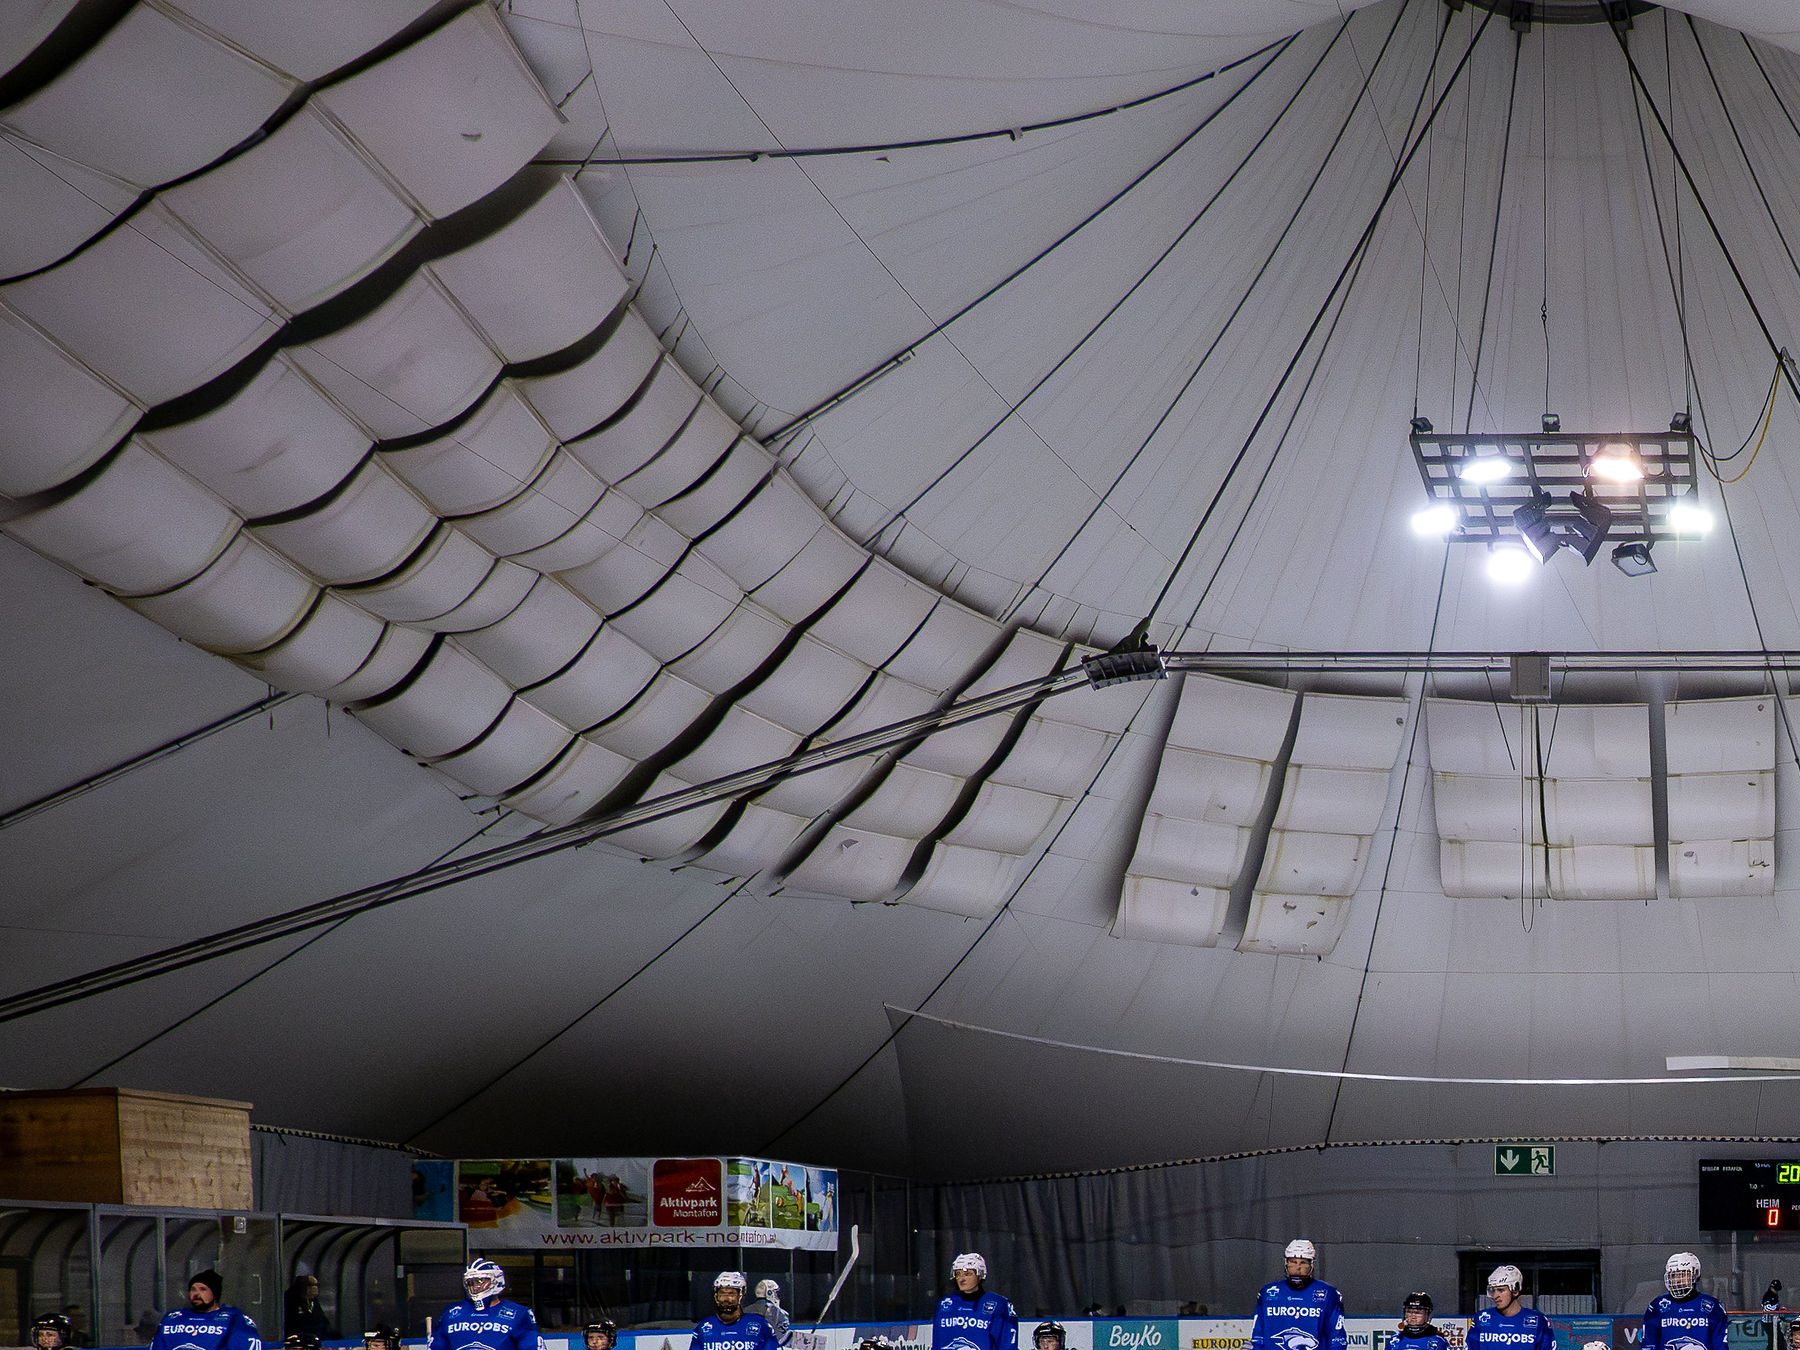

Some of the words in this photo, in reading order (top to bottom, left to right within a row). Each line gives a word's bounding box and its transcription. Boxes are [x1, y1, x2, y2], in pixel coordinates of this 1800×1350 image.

[660, 1197, 717, 1208] Aktivpark
[1756, 1199, 1780, 1208] HEIM
[673, 1208, 718, 1217] Montafon
[1768, 1209, 1779, 1226] 0
